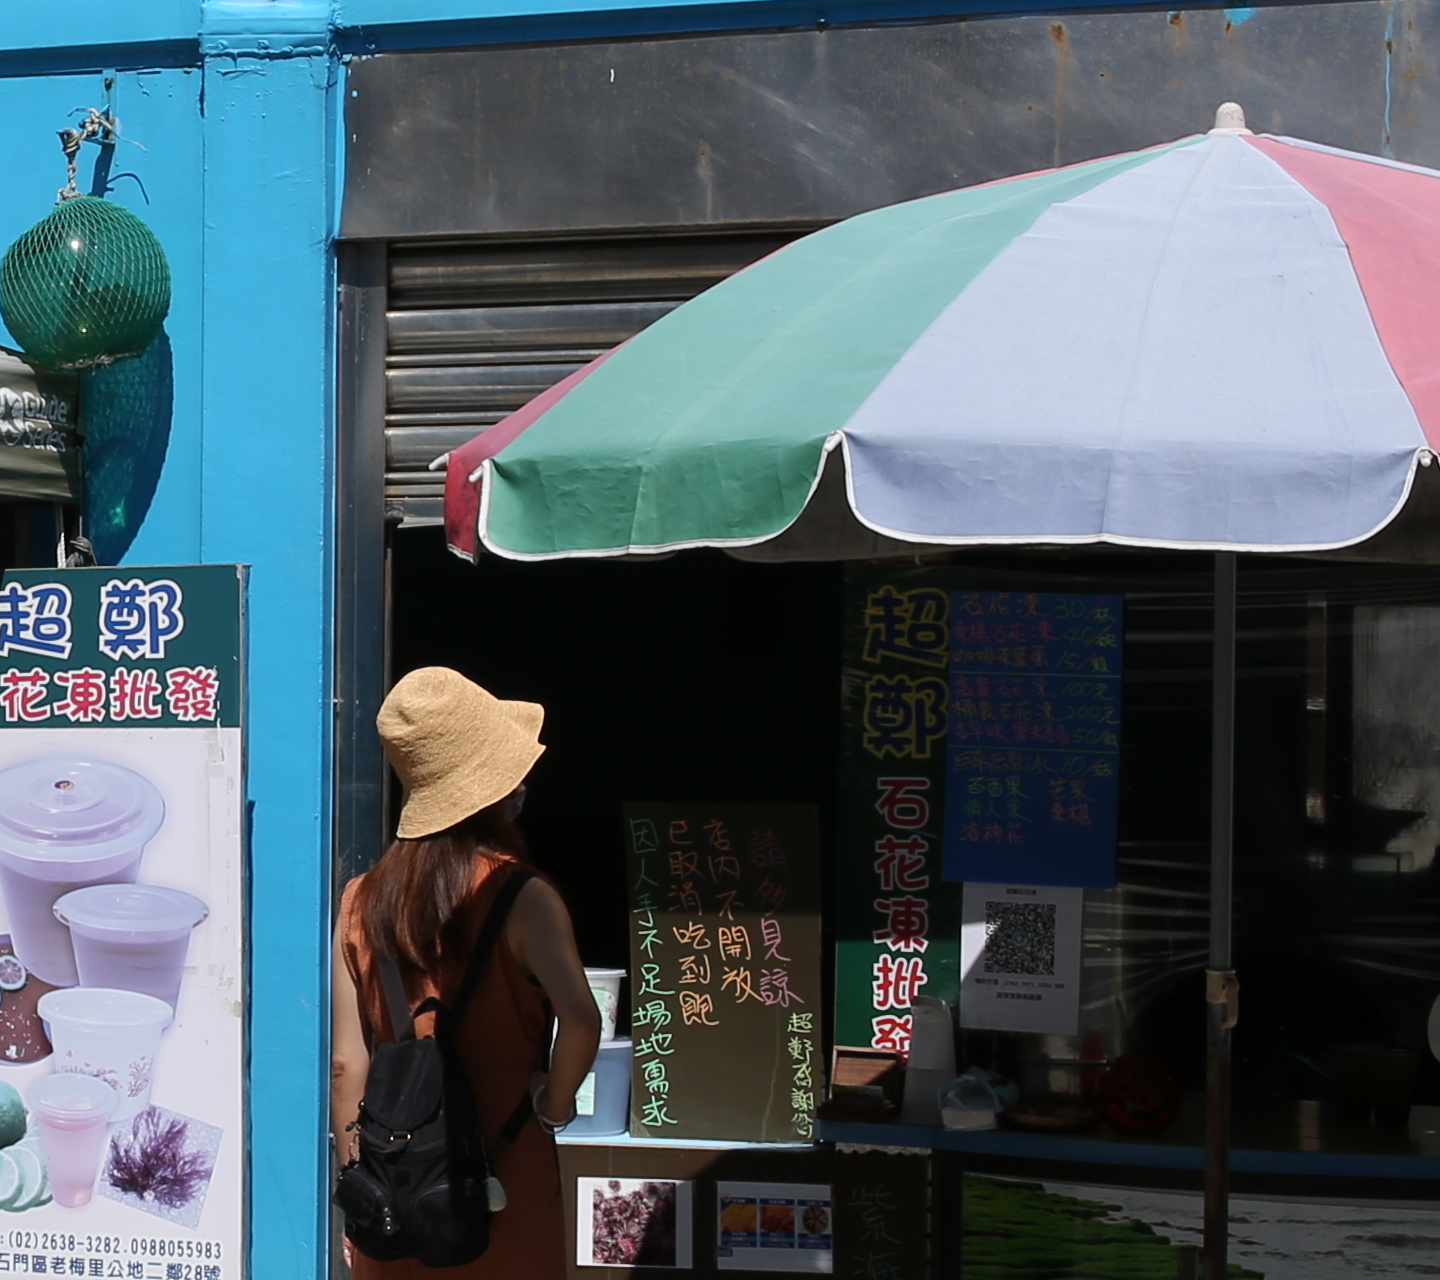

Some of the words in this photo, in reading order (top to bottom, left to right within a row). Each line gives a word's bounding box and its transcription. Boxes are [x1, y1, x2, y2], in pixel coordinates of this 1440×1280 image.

[22, 391, 69, 423] Guide
[22, 421, 67, 452] Series
[863, 585, 949, 759] 超鄭
